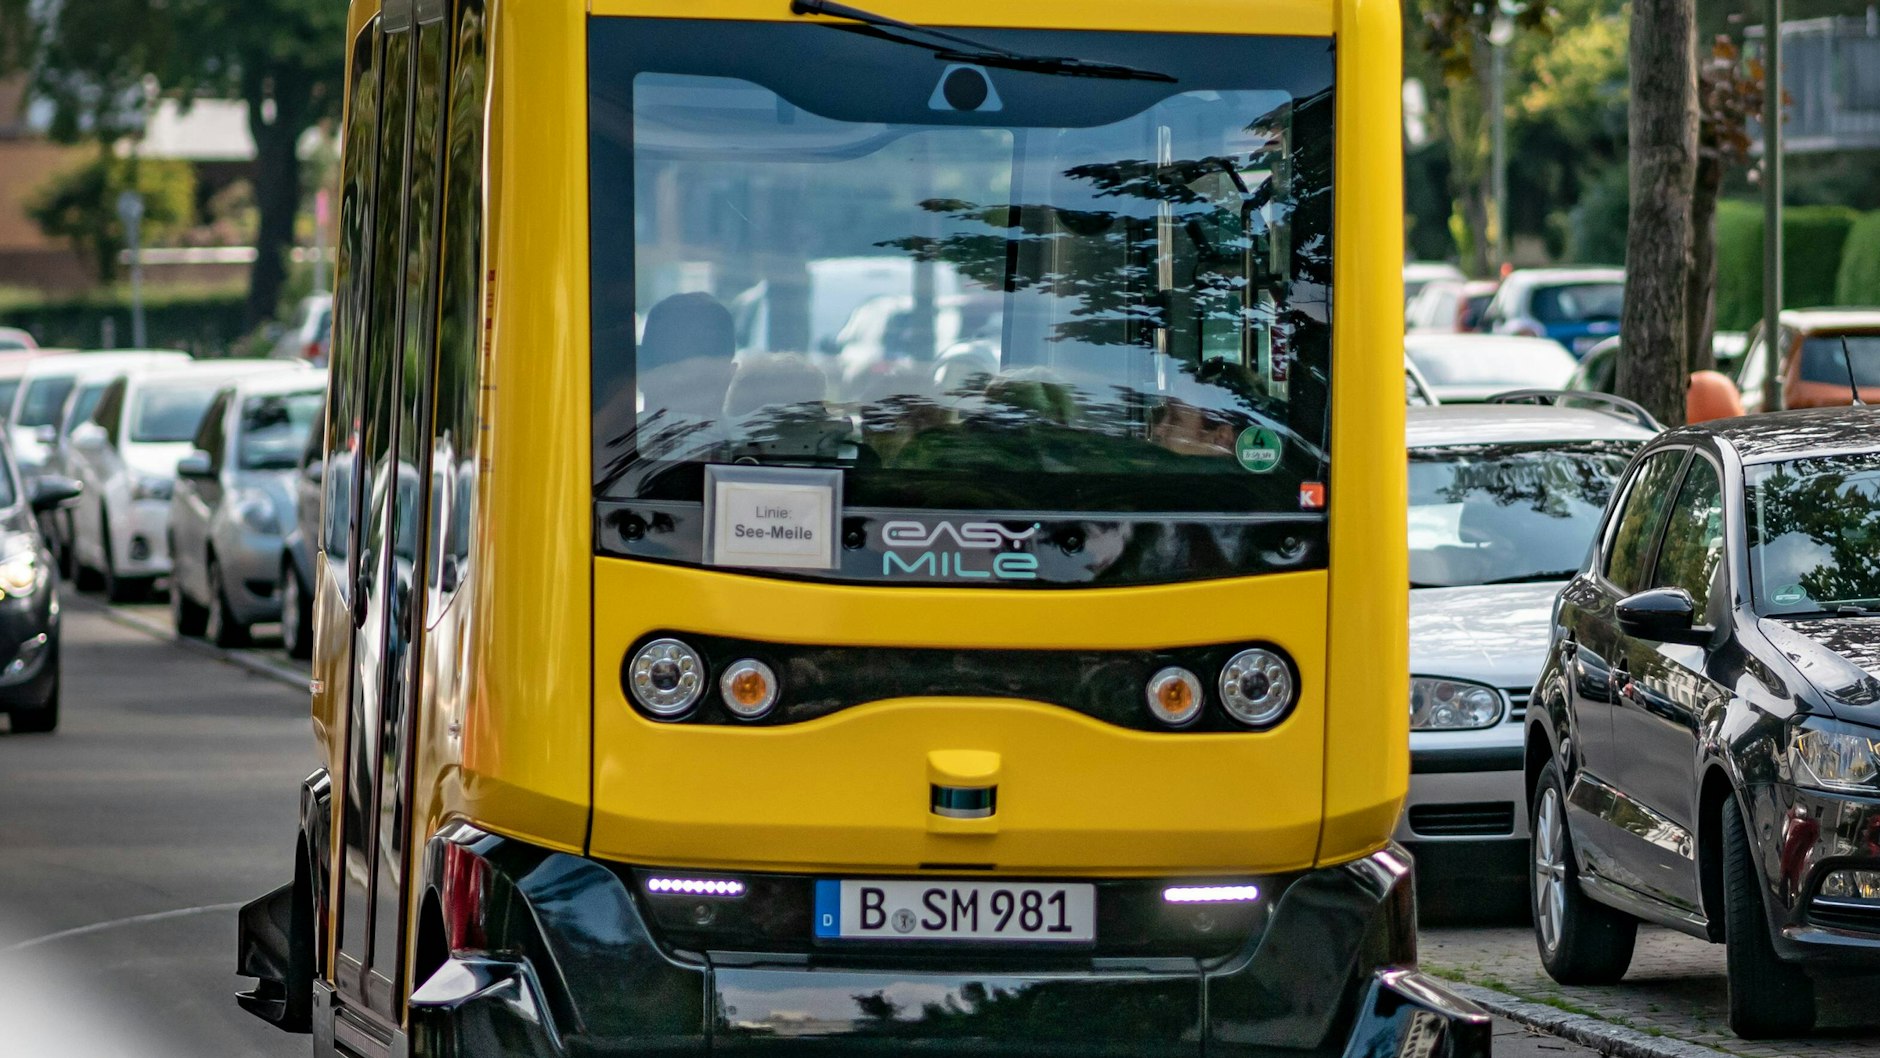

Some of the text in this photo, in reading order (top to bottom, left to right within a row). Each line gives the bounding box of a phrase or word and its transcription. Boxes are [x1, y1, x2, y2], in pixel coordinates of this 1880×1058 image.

[1253, 429, 1265, 448] 4
[755, 506, 793, 520] Linie:
[735, 524, 813, 540] See-Meile
[822, 887, 1073, 933] D B SM 981
